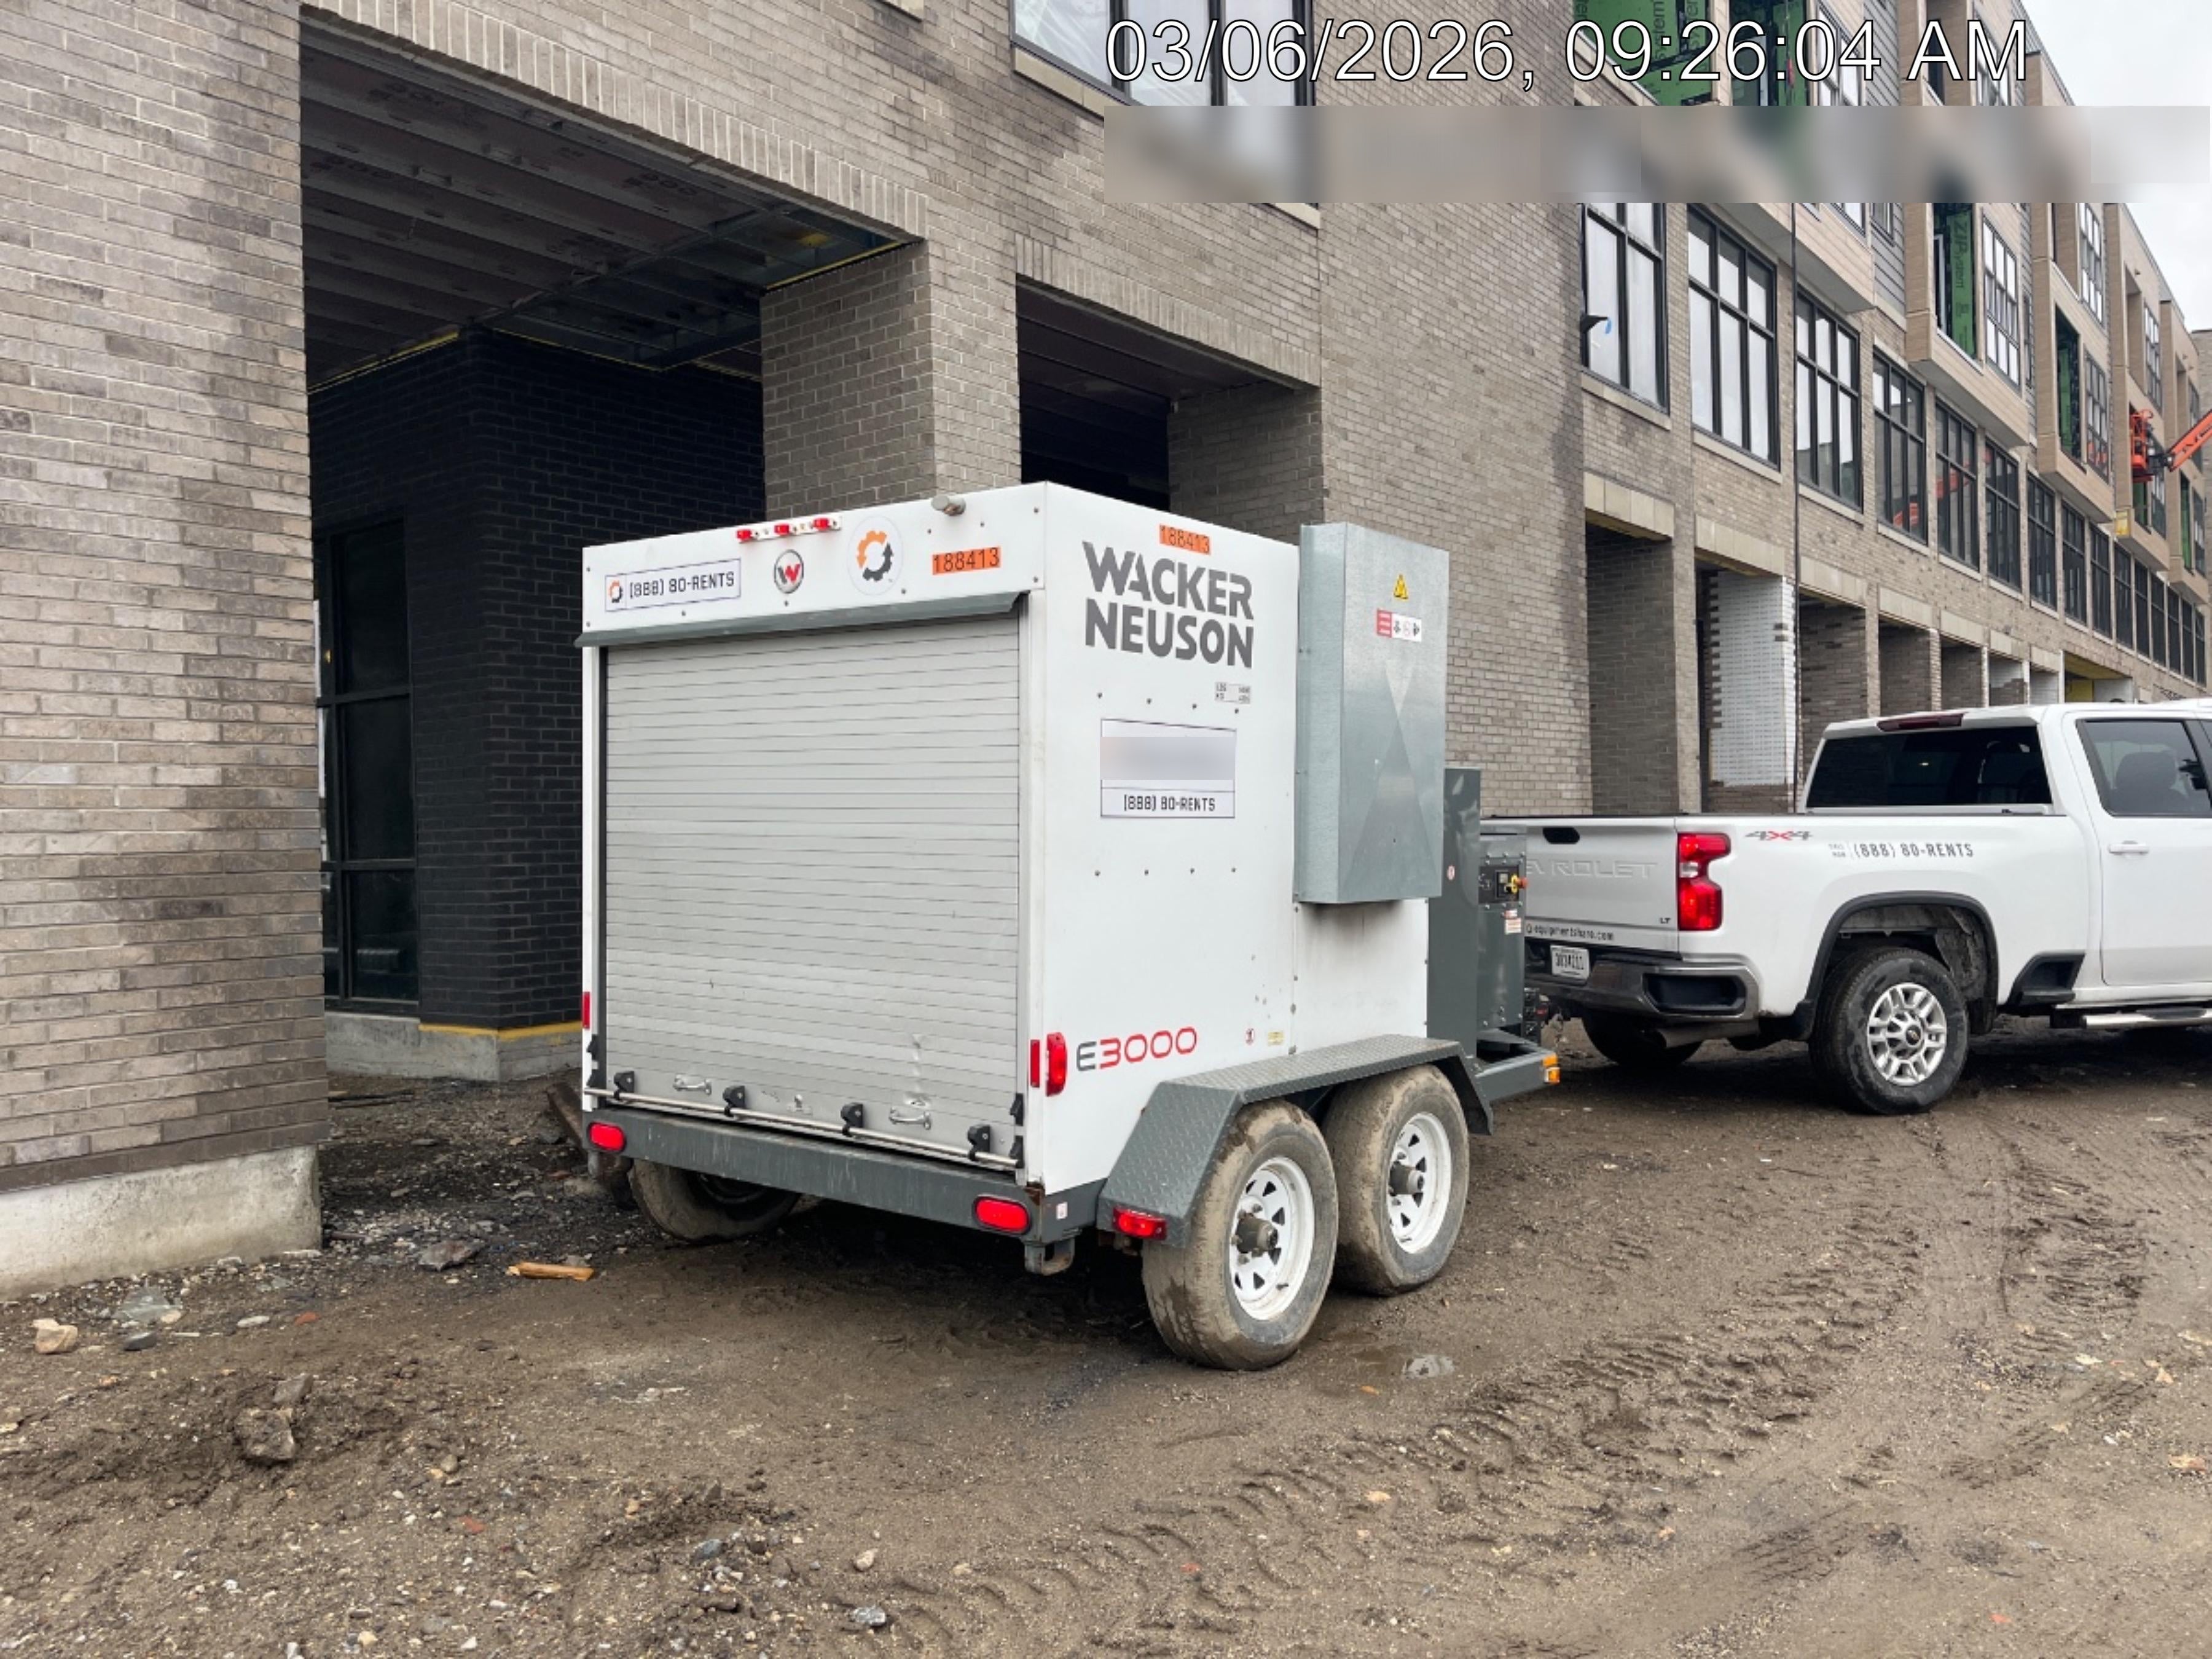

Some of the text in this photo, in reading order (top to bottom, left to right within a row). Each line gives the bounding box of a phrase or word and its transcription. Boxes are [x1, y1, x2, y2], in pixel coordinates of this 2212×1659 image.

[1160, 525, 1210, 554] 188413
[933, 547, 999, 573] 188413
[669, 571, 734, 593] 80-RENTS
[1082, 541, 1254, 620] WACKER
[1085, 598, 1254, 669] NEUSON
[1161, 796, 1215, 812] 80-RENTS
[1854, 842, 1895, 858] (888)
[1900, 843, 1973, 858] 80-RENTS
[1077, 1027, 1198, 1072] E3000
